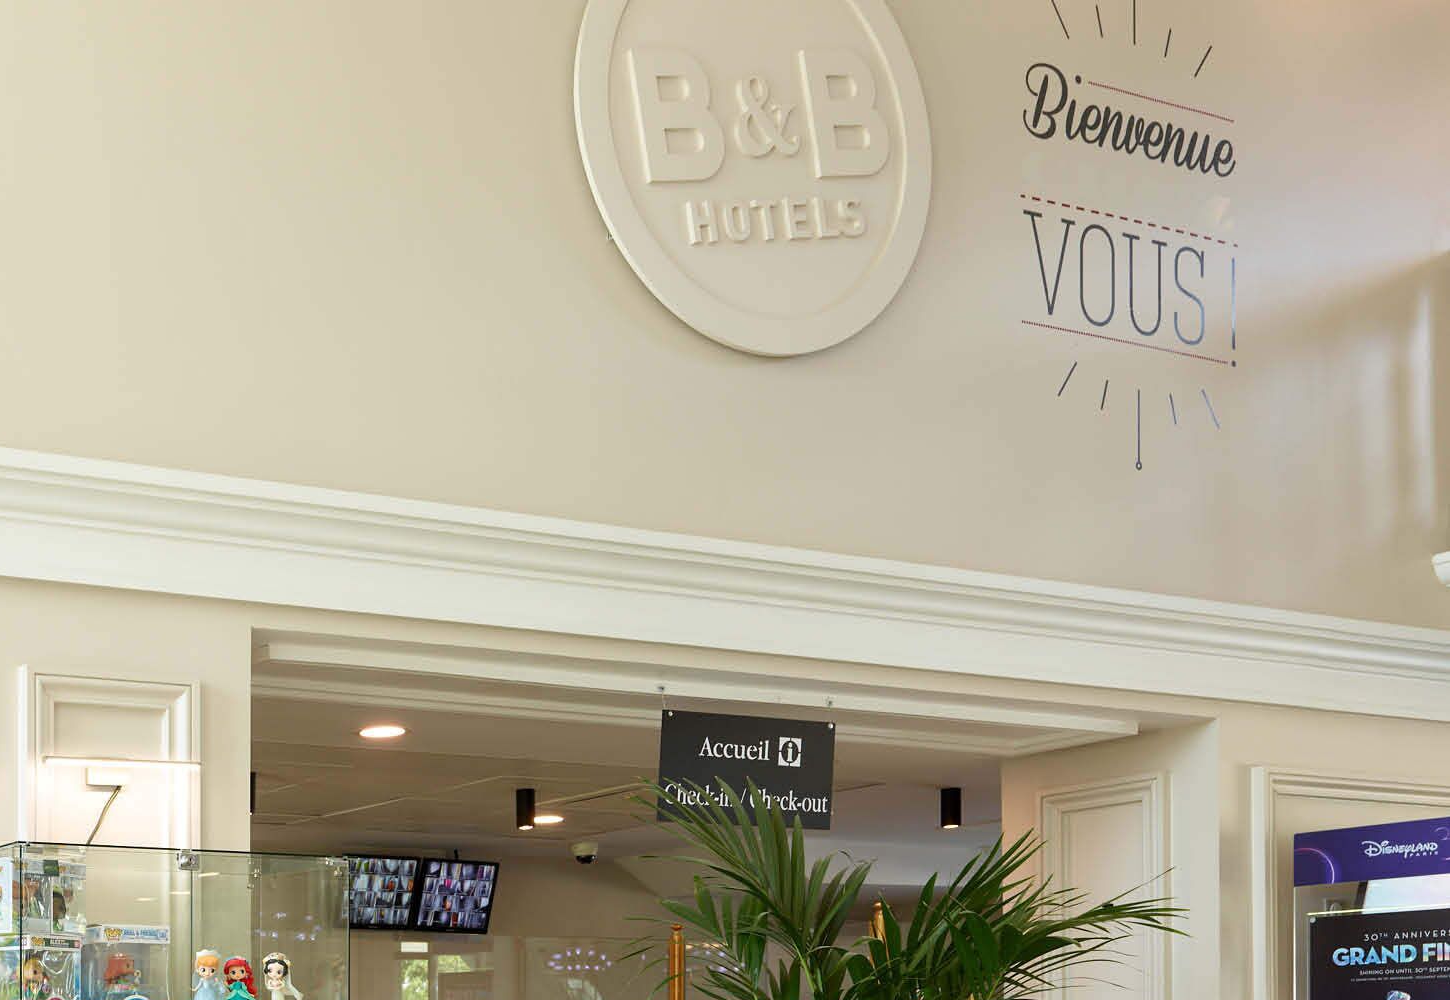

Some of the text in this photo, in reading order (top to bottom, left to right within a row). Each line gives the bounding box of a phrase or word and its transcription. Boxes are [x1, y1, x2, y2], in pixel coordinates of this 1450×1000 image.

[626, 48, 890, 184] B&B
[1023, 62, 1237, 177] Bienvenue
[686, 197, 867, 246] HOTELS
[699, 736, 770, 761] Accueil
[1393, 929, 1450, 940] ANNIVER
[1332, 944, 1417, 967] GRAND
